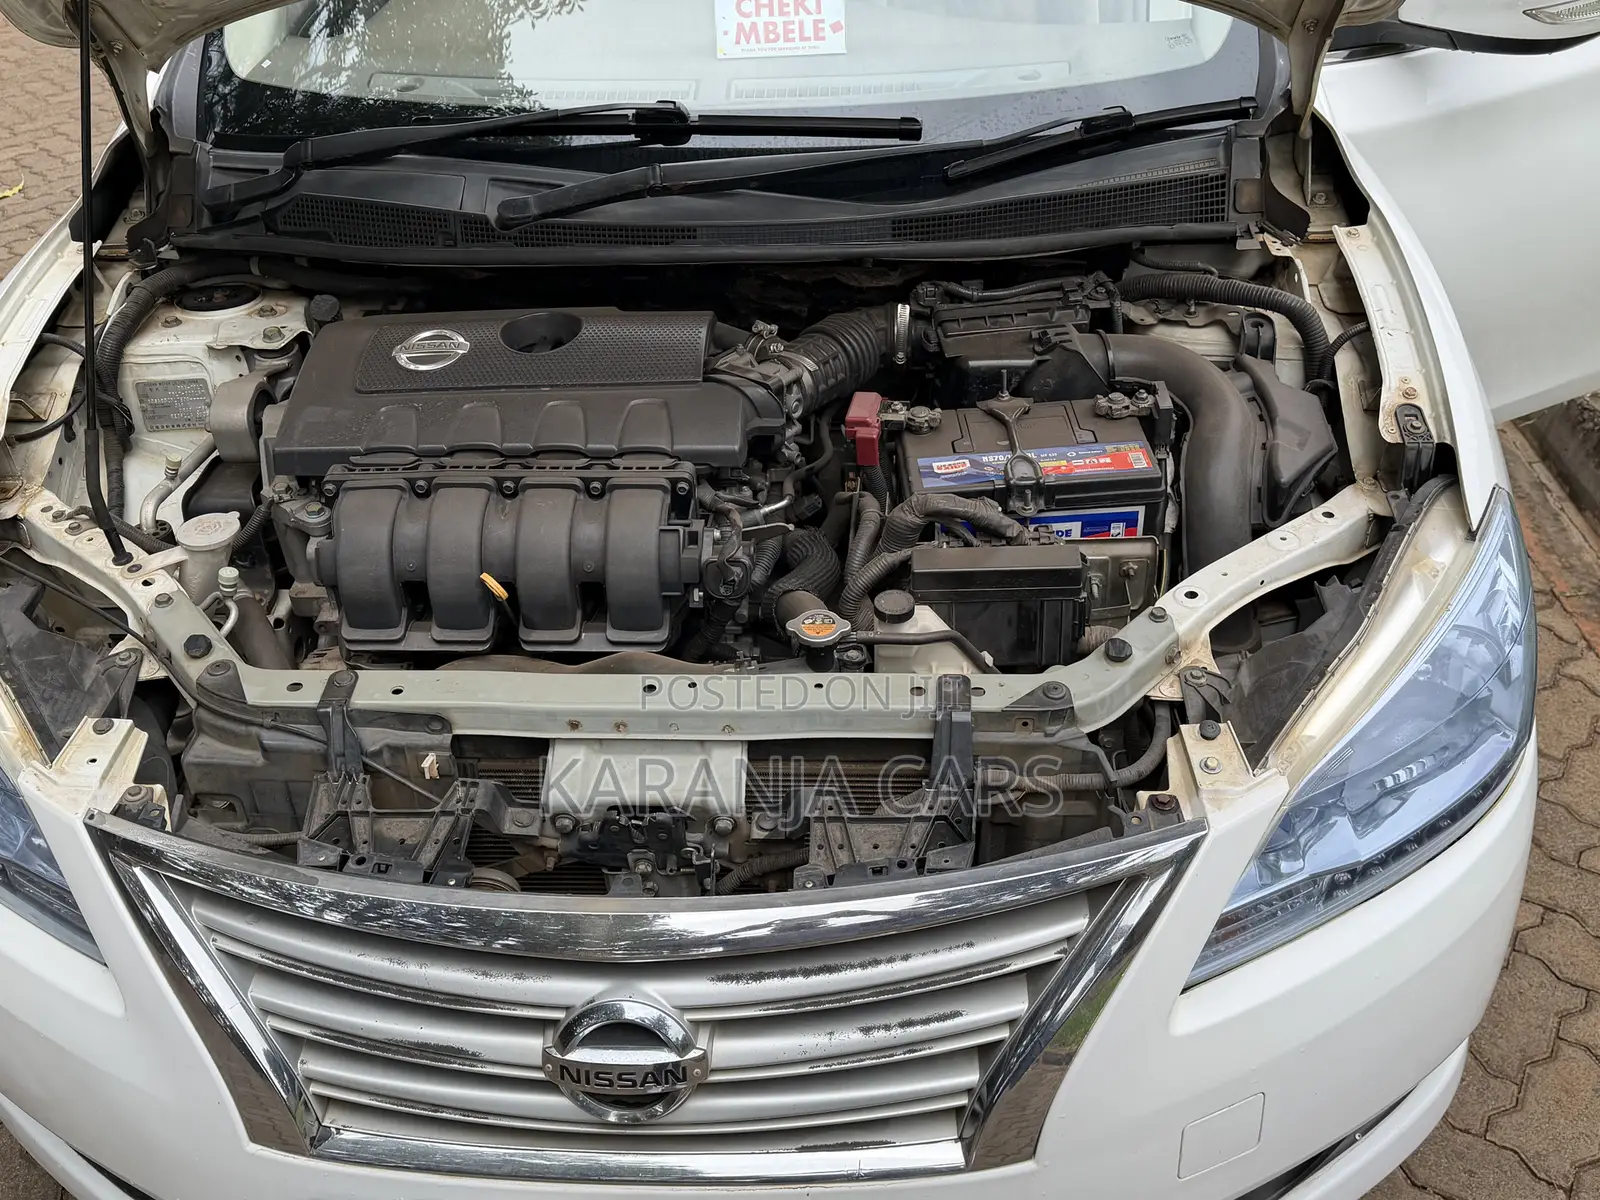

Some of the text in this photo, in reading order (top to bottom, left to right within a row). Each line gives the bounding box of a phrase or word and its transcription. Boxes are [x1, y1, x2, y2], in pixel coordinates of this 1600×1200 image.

[735, 19, 826, 45] MBELE
[400, 342, 460, 351] NISSAN
[559, 1065, 688, 1089] NISSAN
